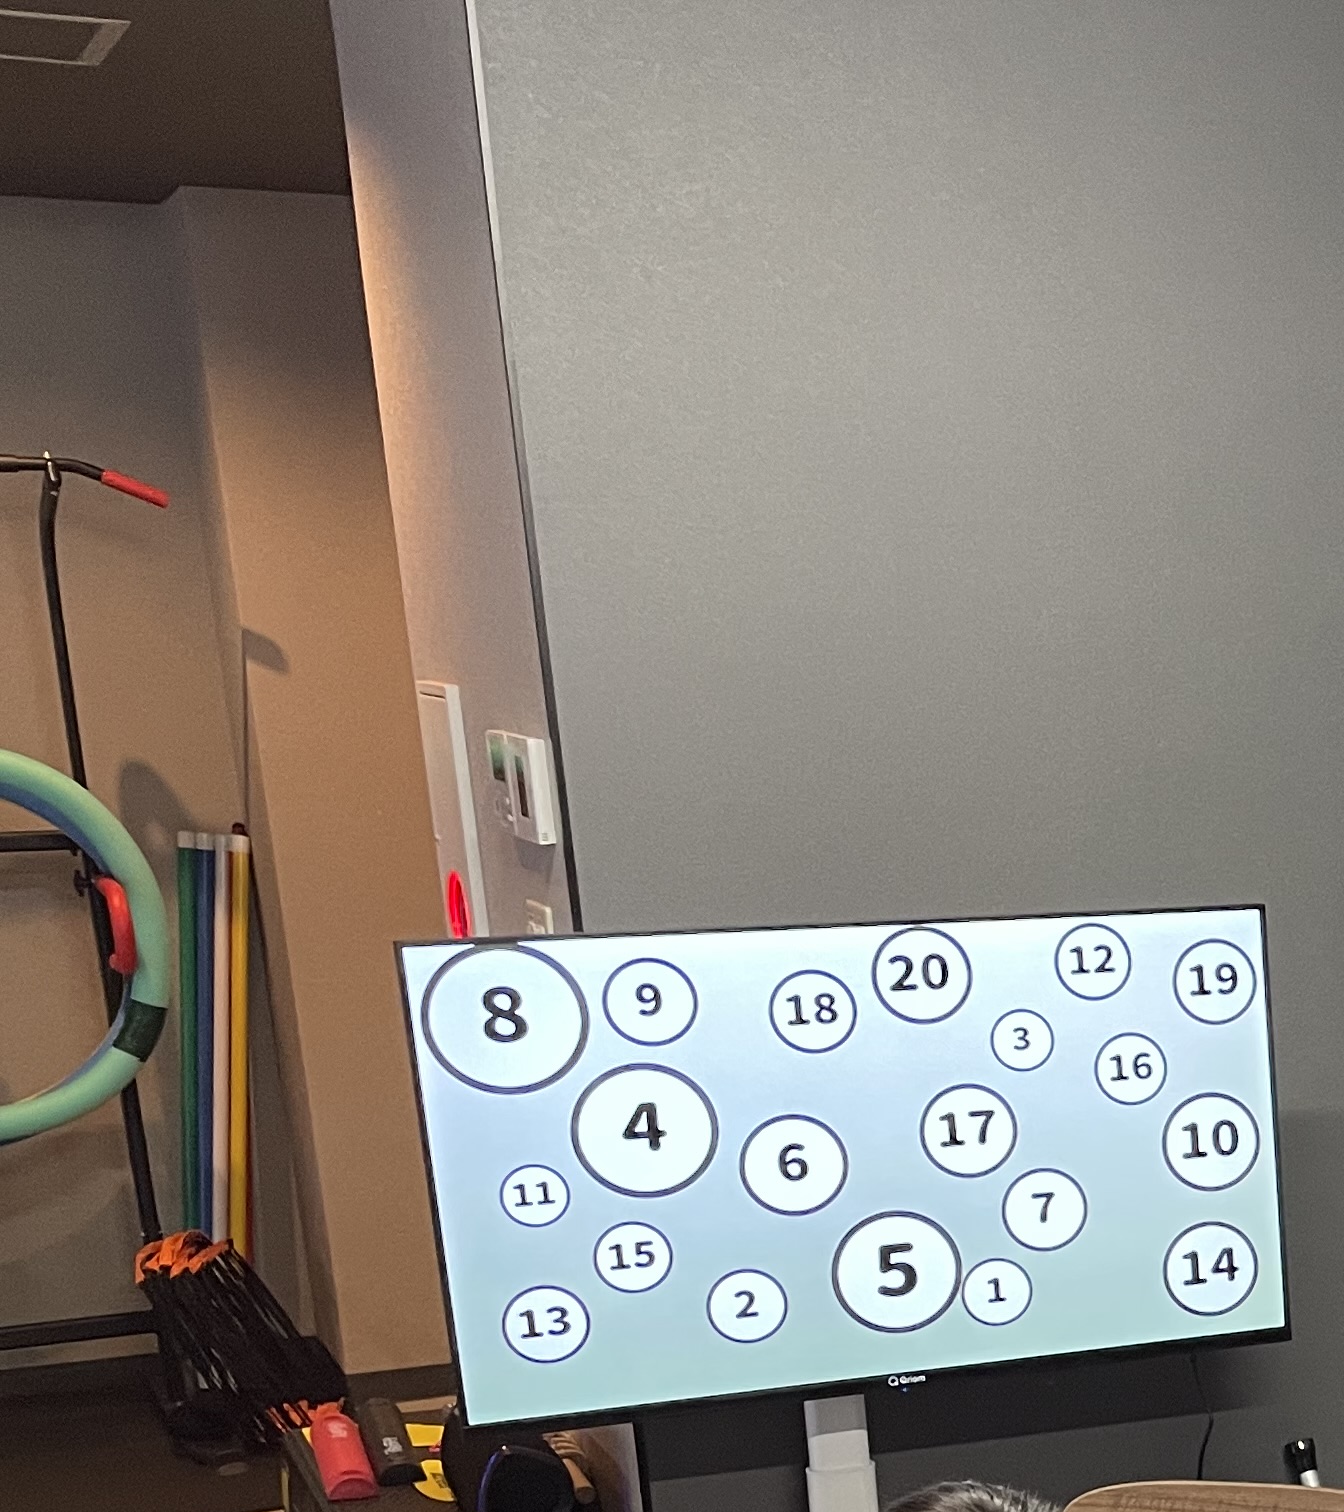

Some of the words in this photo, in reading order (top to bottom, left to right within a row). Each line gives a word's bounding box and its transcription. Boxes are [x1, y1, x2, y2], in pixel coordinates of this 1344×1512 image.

[888, 953, 949, 992] 20
[1069, 945, 1115, 974] 12
[1190, 963, 1238, 996] 19
[482, 986, 528, 1043] 8
[636, 983, 662, 1016] 9
[786, 993, 838, 1026] 18
[1013, 1027, 1030, 1050] 3
[1110, 1052, 1152, 1082] 16
[622, 1102, 667, 1151] 4
[939, 1110, 995, 1148] 17
[1182, 1119, 1239, 1159] 10
[779, 1143, 808, 1181] 6
[514, 1181, 556, 1207] 11
[1031, 1192, 1055, 1223] 7
[608, 1241, 655, 1270] 15
[878, 1243, 918, 1297] 5
[1182, 1247, 1239, 1286] 14
[734, 1290, 759, 1318] 2
[987, 1278, 1007, 1303] 1
[519, 1307, 571, 1338] 13
